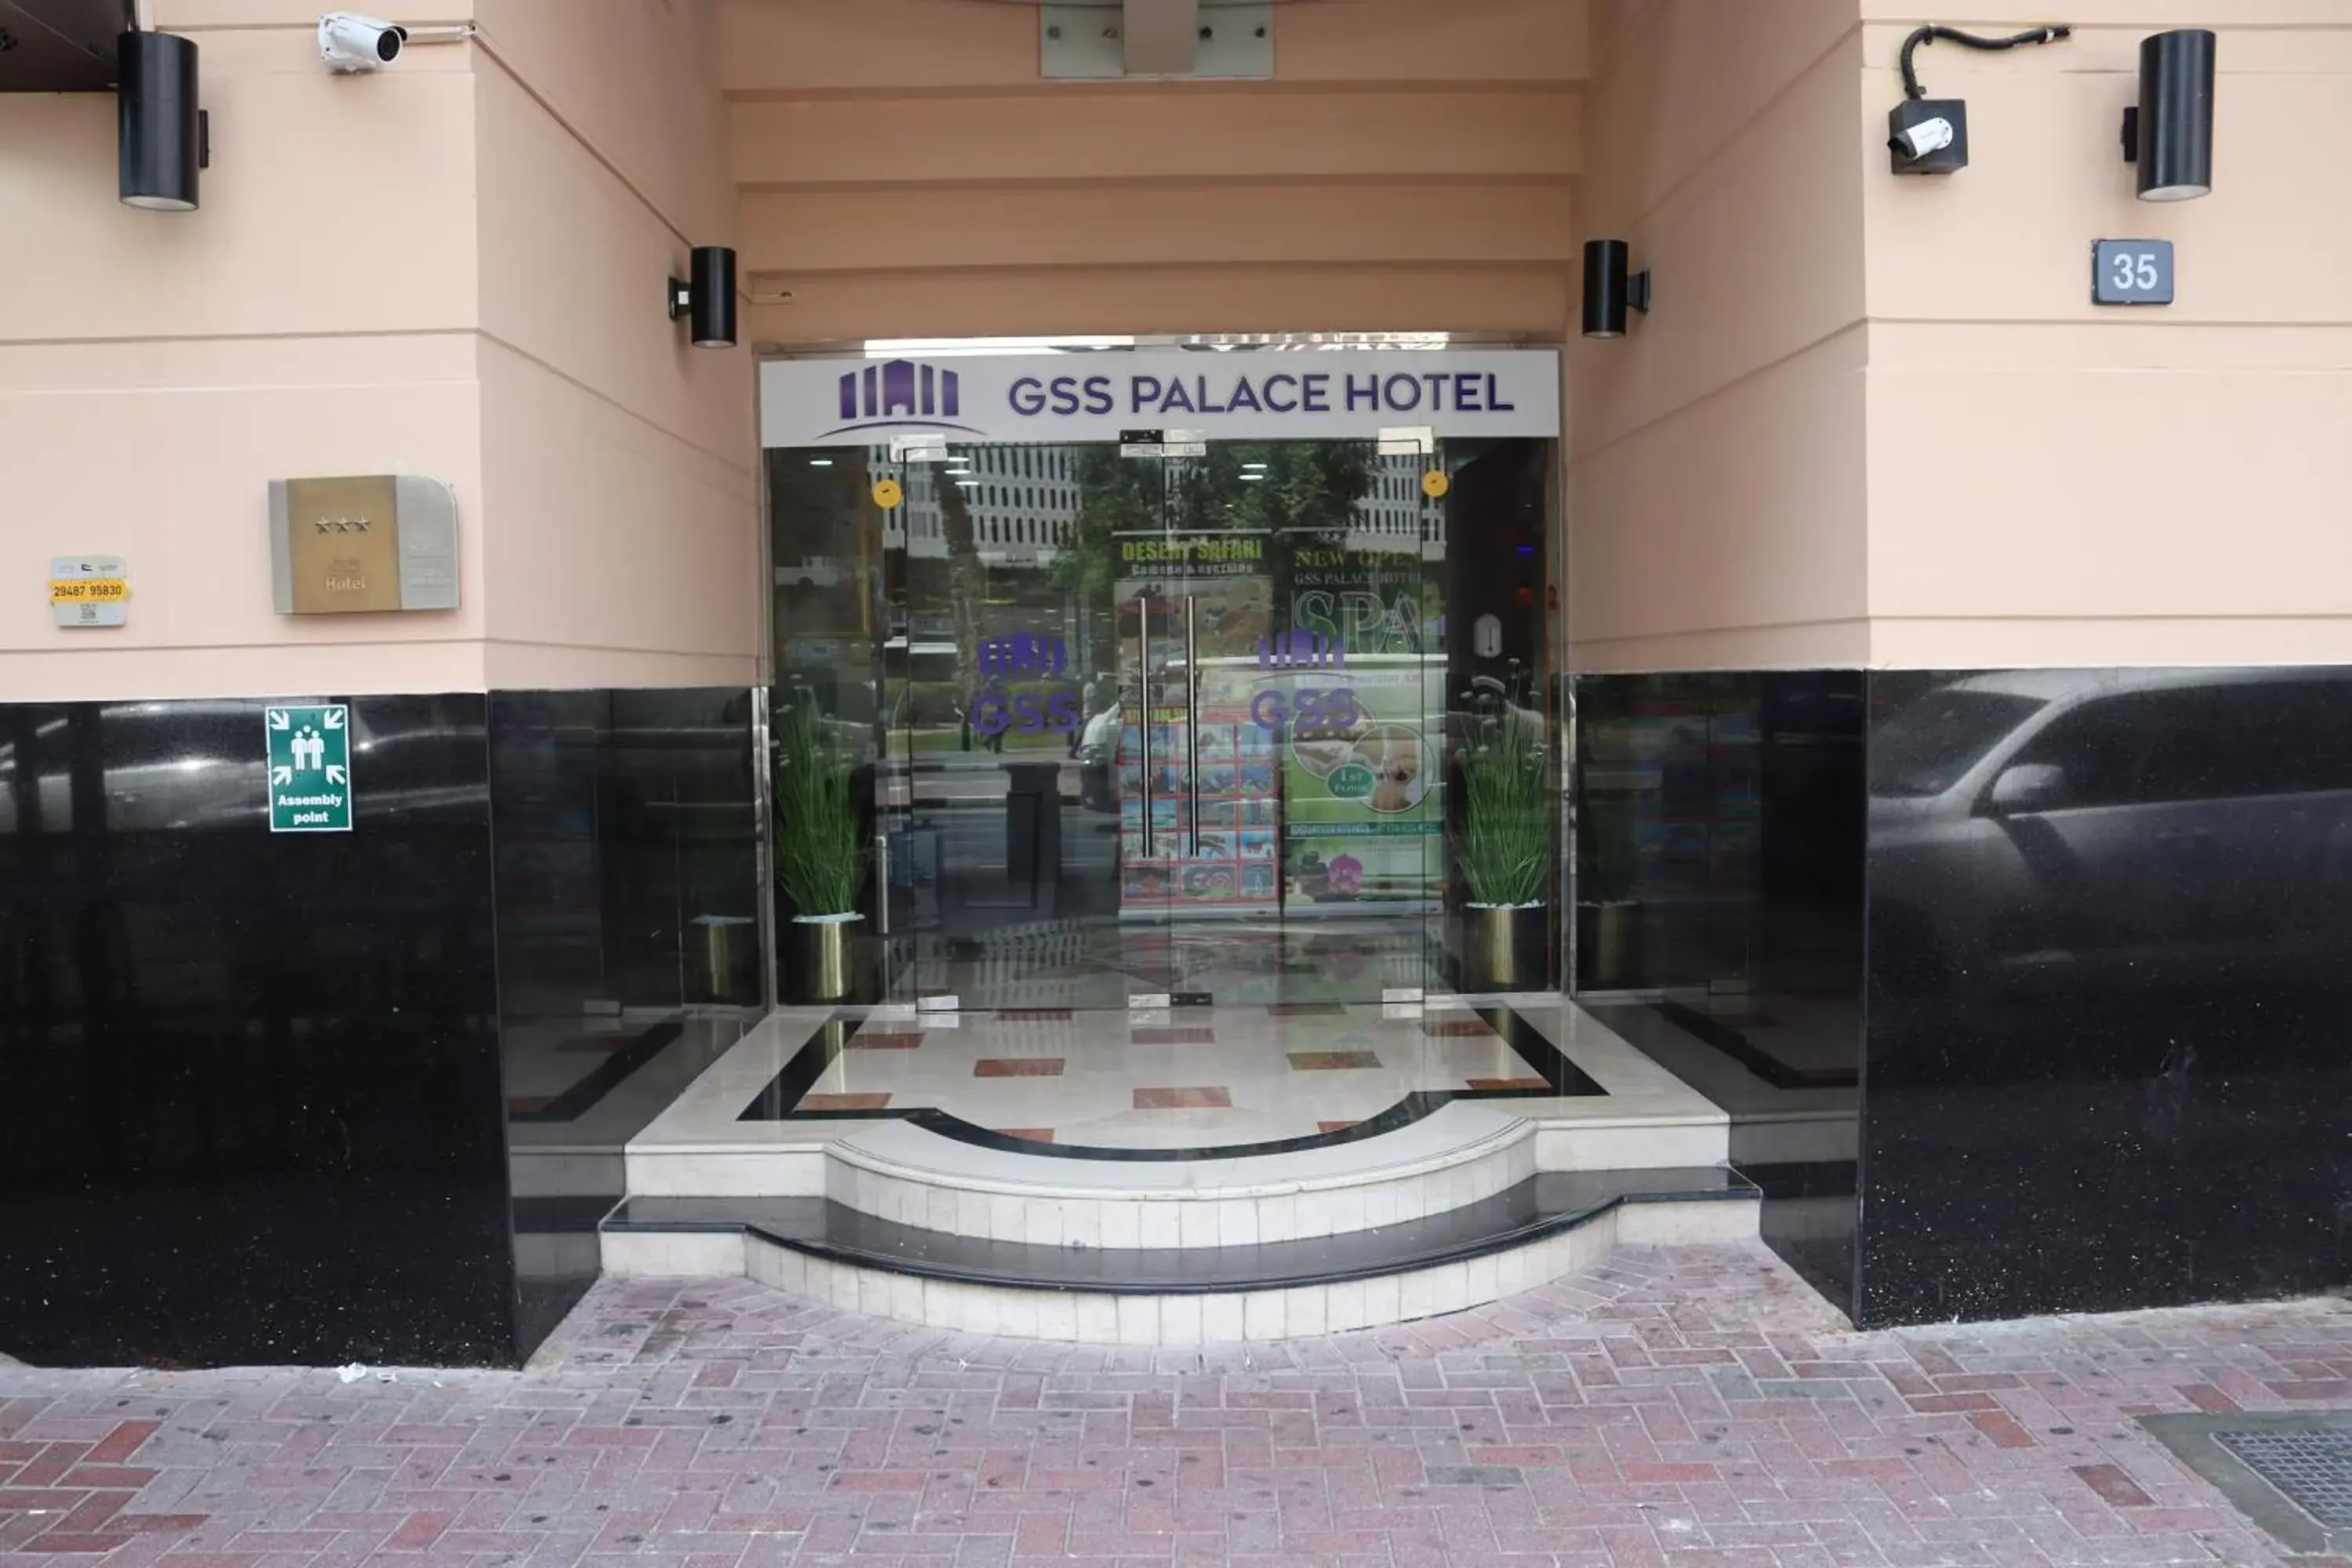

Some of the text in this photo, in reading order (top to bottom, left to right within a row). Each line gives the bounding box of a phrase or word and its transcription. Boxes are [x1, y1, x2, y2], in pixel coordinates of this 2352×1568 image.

[2113, 253, 2158, 290] 35
[1008, 372, 1515, 415] GSS PALACE HOTEL
[1197, 536, 1262, 560] SAFARI
[1295, 550, 1347, 567] NEW
[90, 585, 122, 595] 95830
[325, 576, 365, 590] Hotel
[1295, 590, 1422, 655] SPA
[971, 691, 1079, 735] GSS
[1250, 688, 1359, 730] GSS
[278, 793, 342, 807] Assembly
[293, 811, 329, 825] point
